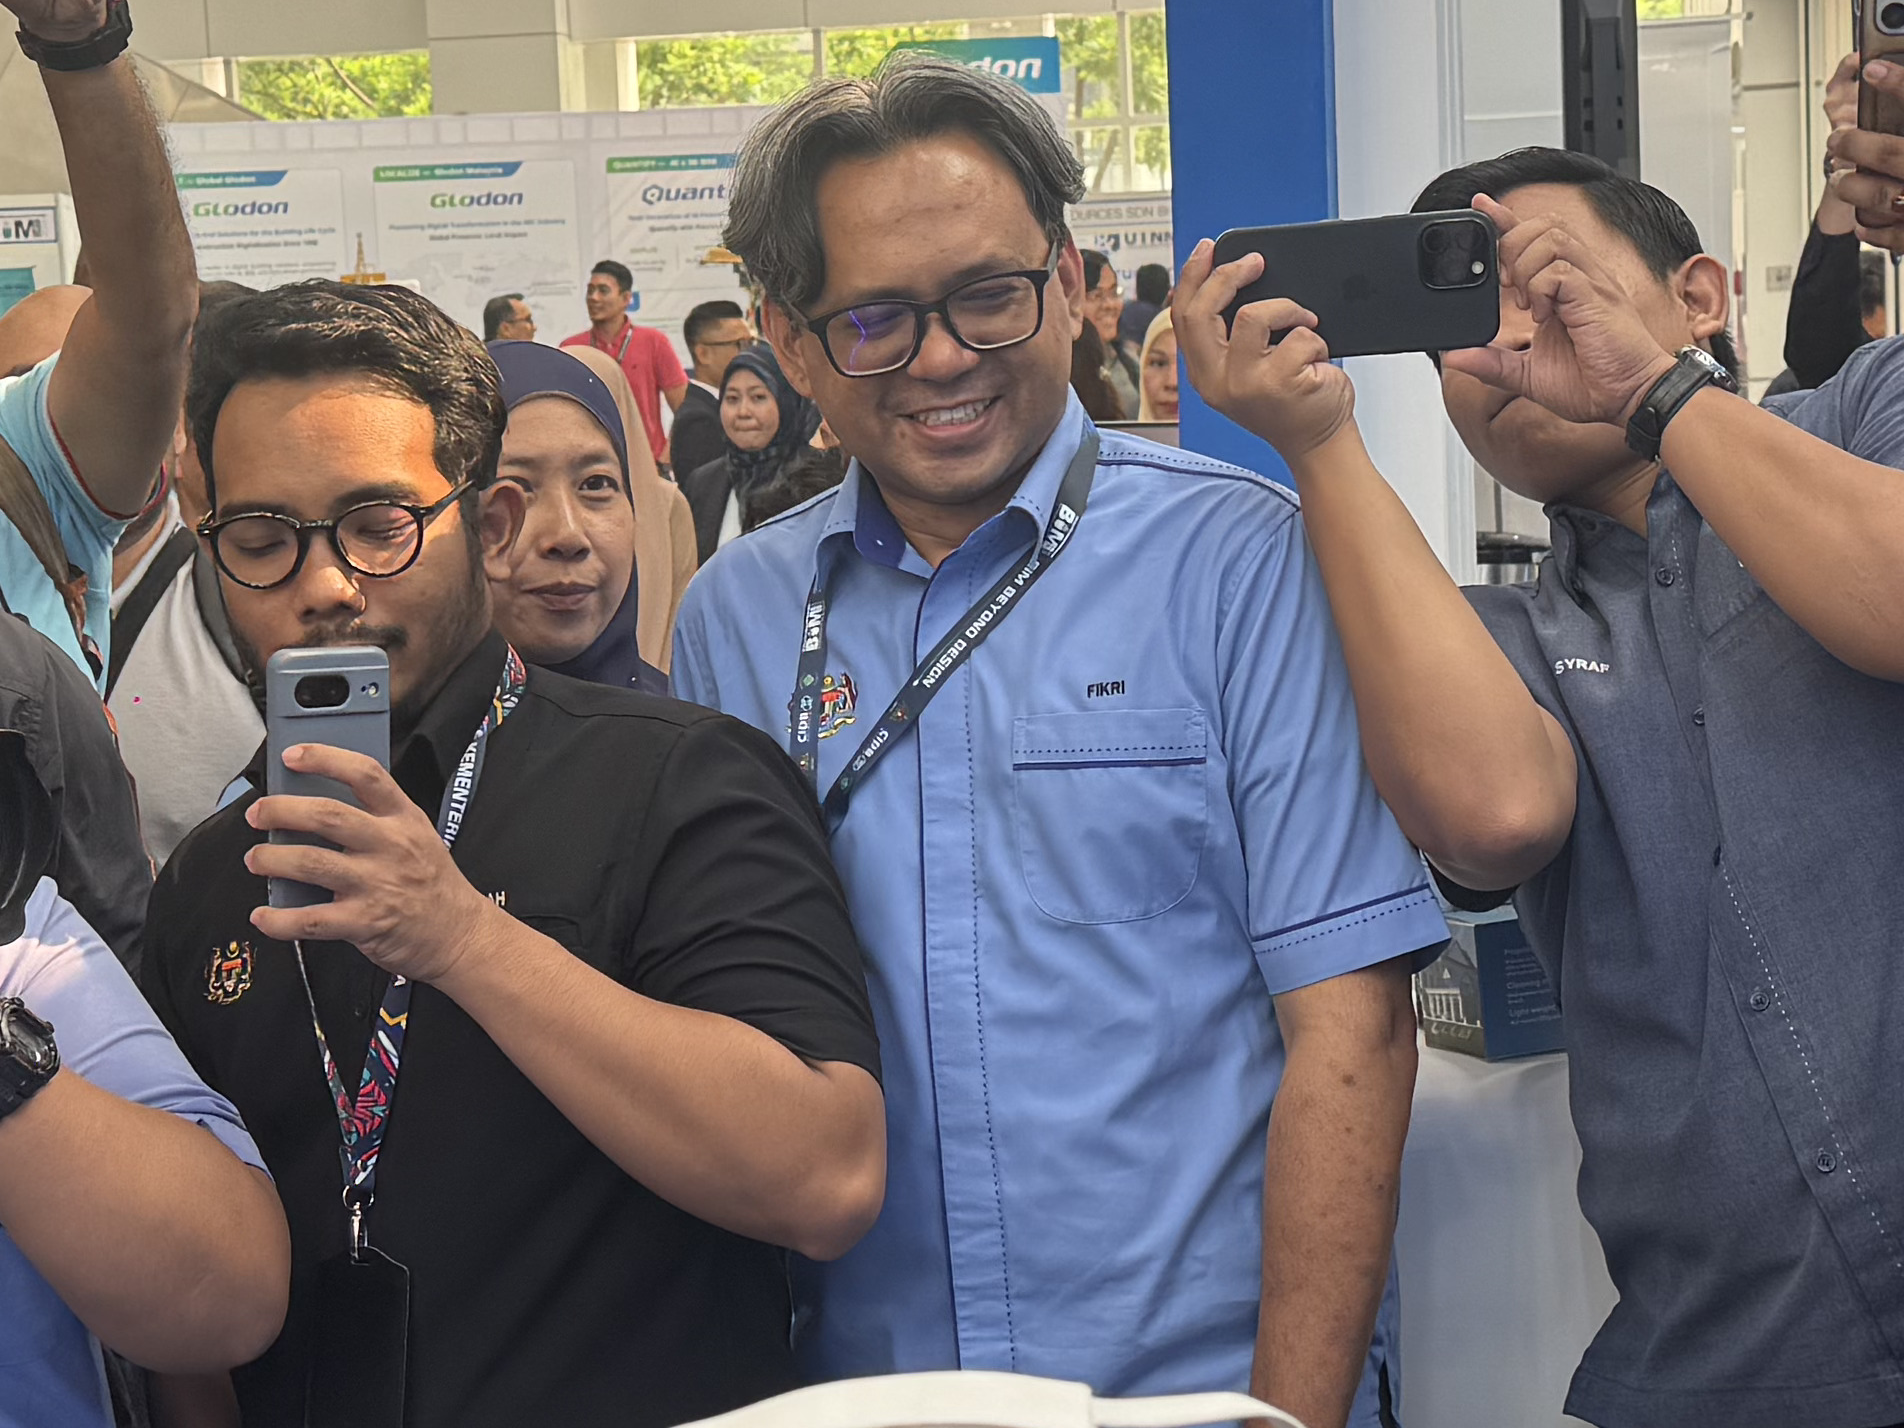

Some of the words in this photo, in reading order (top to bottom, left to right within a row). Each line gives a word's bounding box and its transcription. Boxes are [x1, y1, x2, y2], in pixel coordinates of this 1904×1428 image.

[641, 183, 726, 206] Quant
[964, 585, 1017, 640] BEYOND
[921, 639, 968, 689] DESIGN
[1086, 679, 1126, 699] FIKRI
